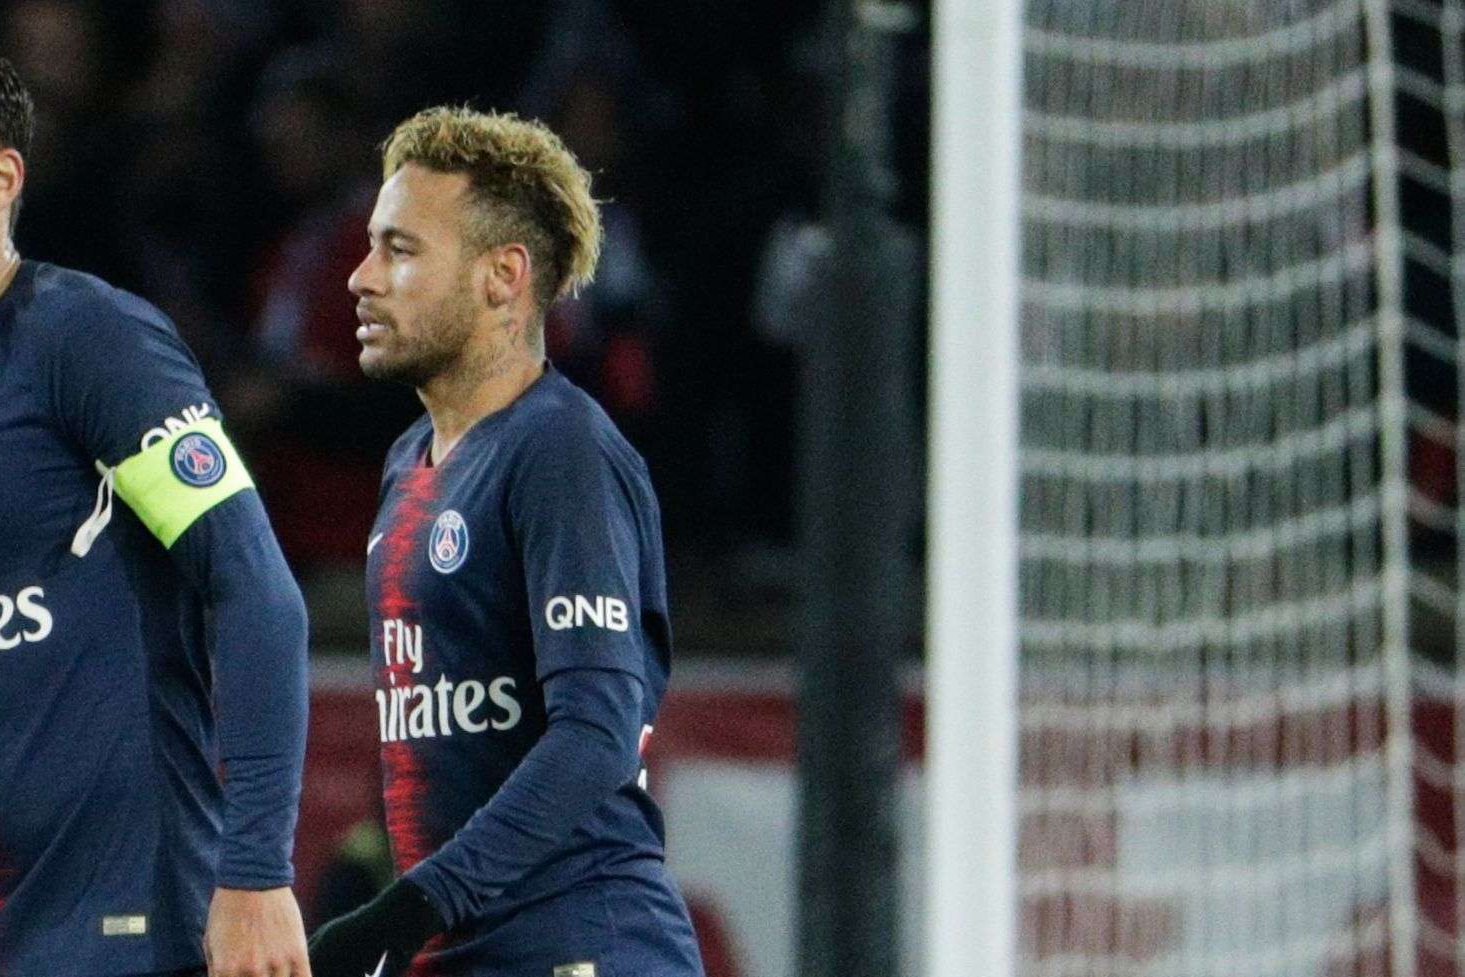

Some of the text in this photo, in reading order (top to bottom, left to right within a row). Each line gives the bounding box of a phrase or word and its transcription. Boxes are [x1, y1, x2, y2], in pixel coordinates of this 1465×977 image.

[545, 594, 629, 632] QNB
[383, 618, 423, 673] Fly
[375, 672, 522, 743] irates
